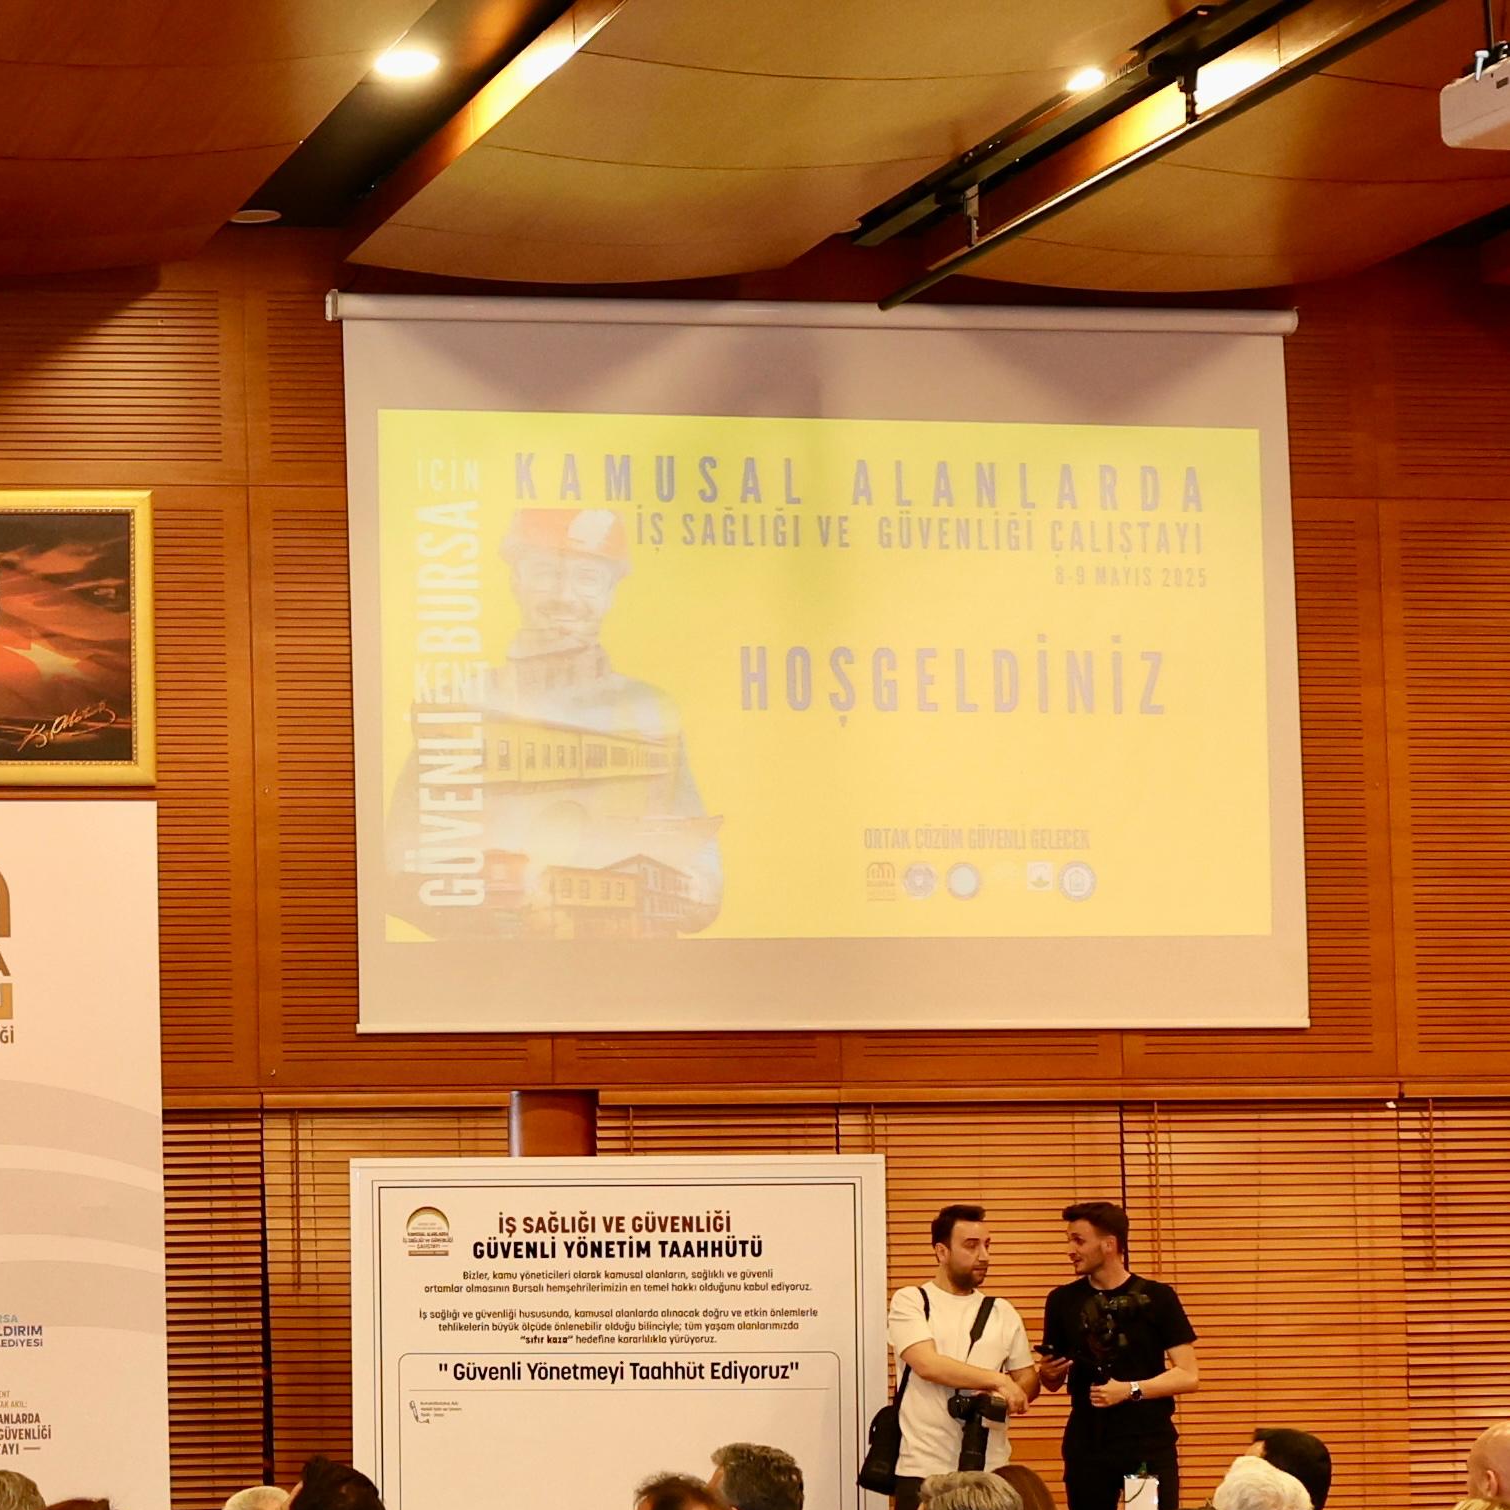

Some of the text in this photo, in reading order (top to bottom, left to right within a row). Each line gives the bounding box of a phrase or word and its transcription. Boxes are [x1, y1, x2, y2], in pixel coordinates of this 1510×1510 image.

[515, 452, 1203, 513] KAMUSAL ALANLARDA
[636, 505, 1203, 560] İŞ SAĞLIĞI VE GÜVENLİĞİ ÇALIŞTAYI
[417, 500, 480, 654] BURSA
[1055, 565, 1207, 588] 8-9 MAYIS 2025
[415, 660, 490, 704] KENT
[739, 633, 1167, 728] HOŞGELDİNİZ
[404, 712, 484, 907] GÜVENLİ
[499, 1210, 731, 1237] İŞ SAĞLIĞI VE GÜVENLİĞİ
[473, 1235, 762, 1259] GÜVENLİ YÖNETİM TAAHHÜTÜ
[424, 1284, 463, 1292] ortamlar
[466, 1284, 509, 1292] olmasının
[512, 1284, 544, 1292] Bursalı
[547, 1283, 627, 1293] hemşehrilerimizin
[644, 1283, 669, 1291] temel
[672, 1283, 696, 1291] hakkı
[699, 1283, 741, 1293] olduğunu
[744, 1283, 768, 1291] kabul
[771, 1282, 812, 1292] ediyoruz.
[463, 1272, 490, 1280] Bizler,
[493, 1271, 517, 1279] kamu
[520, 1271, 570, 1281] yöneticileri
[573, 1271, 601, 1279] olarak
[605, 1270, 643, 1279] kamusal
[646, 1270, 688, 1280] alanların,
[692, 1269, 724, 1280] sağlıklı
[740, 1269, 773, 1280] güvenli
[419, 1309, 427, 1319] İş
[430, 1310, 460, 1320] sağlığı
[476, 1309, 516, 1320] güvenliği
[519, 1310, 571, 1319] hususunda,
[574, 1309, 613, 1318] kamusal
[616, 1309, 659, 1317] alanlarda
[661, 1309, 699, 1317] alınacak
[703, 1308, 728, 1319] doğru
[745, 1308, 767, 1317] etkin
[770, 1308, 818, 1317] önlemlerle
[439, 1321, 798, 1332] tehlikelerin büyük ölçüde önlenebilir olduğu bilinciyle; tüm yaşam alanlarımızda
[453, 1362, 521, 1380] Güvenli
[528, 1361, 624, 1384] Yönetmeyi
[630, 1361, 704, 1380] Taahhüt
